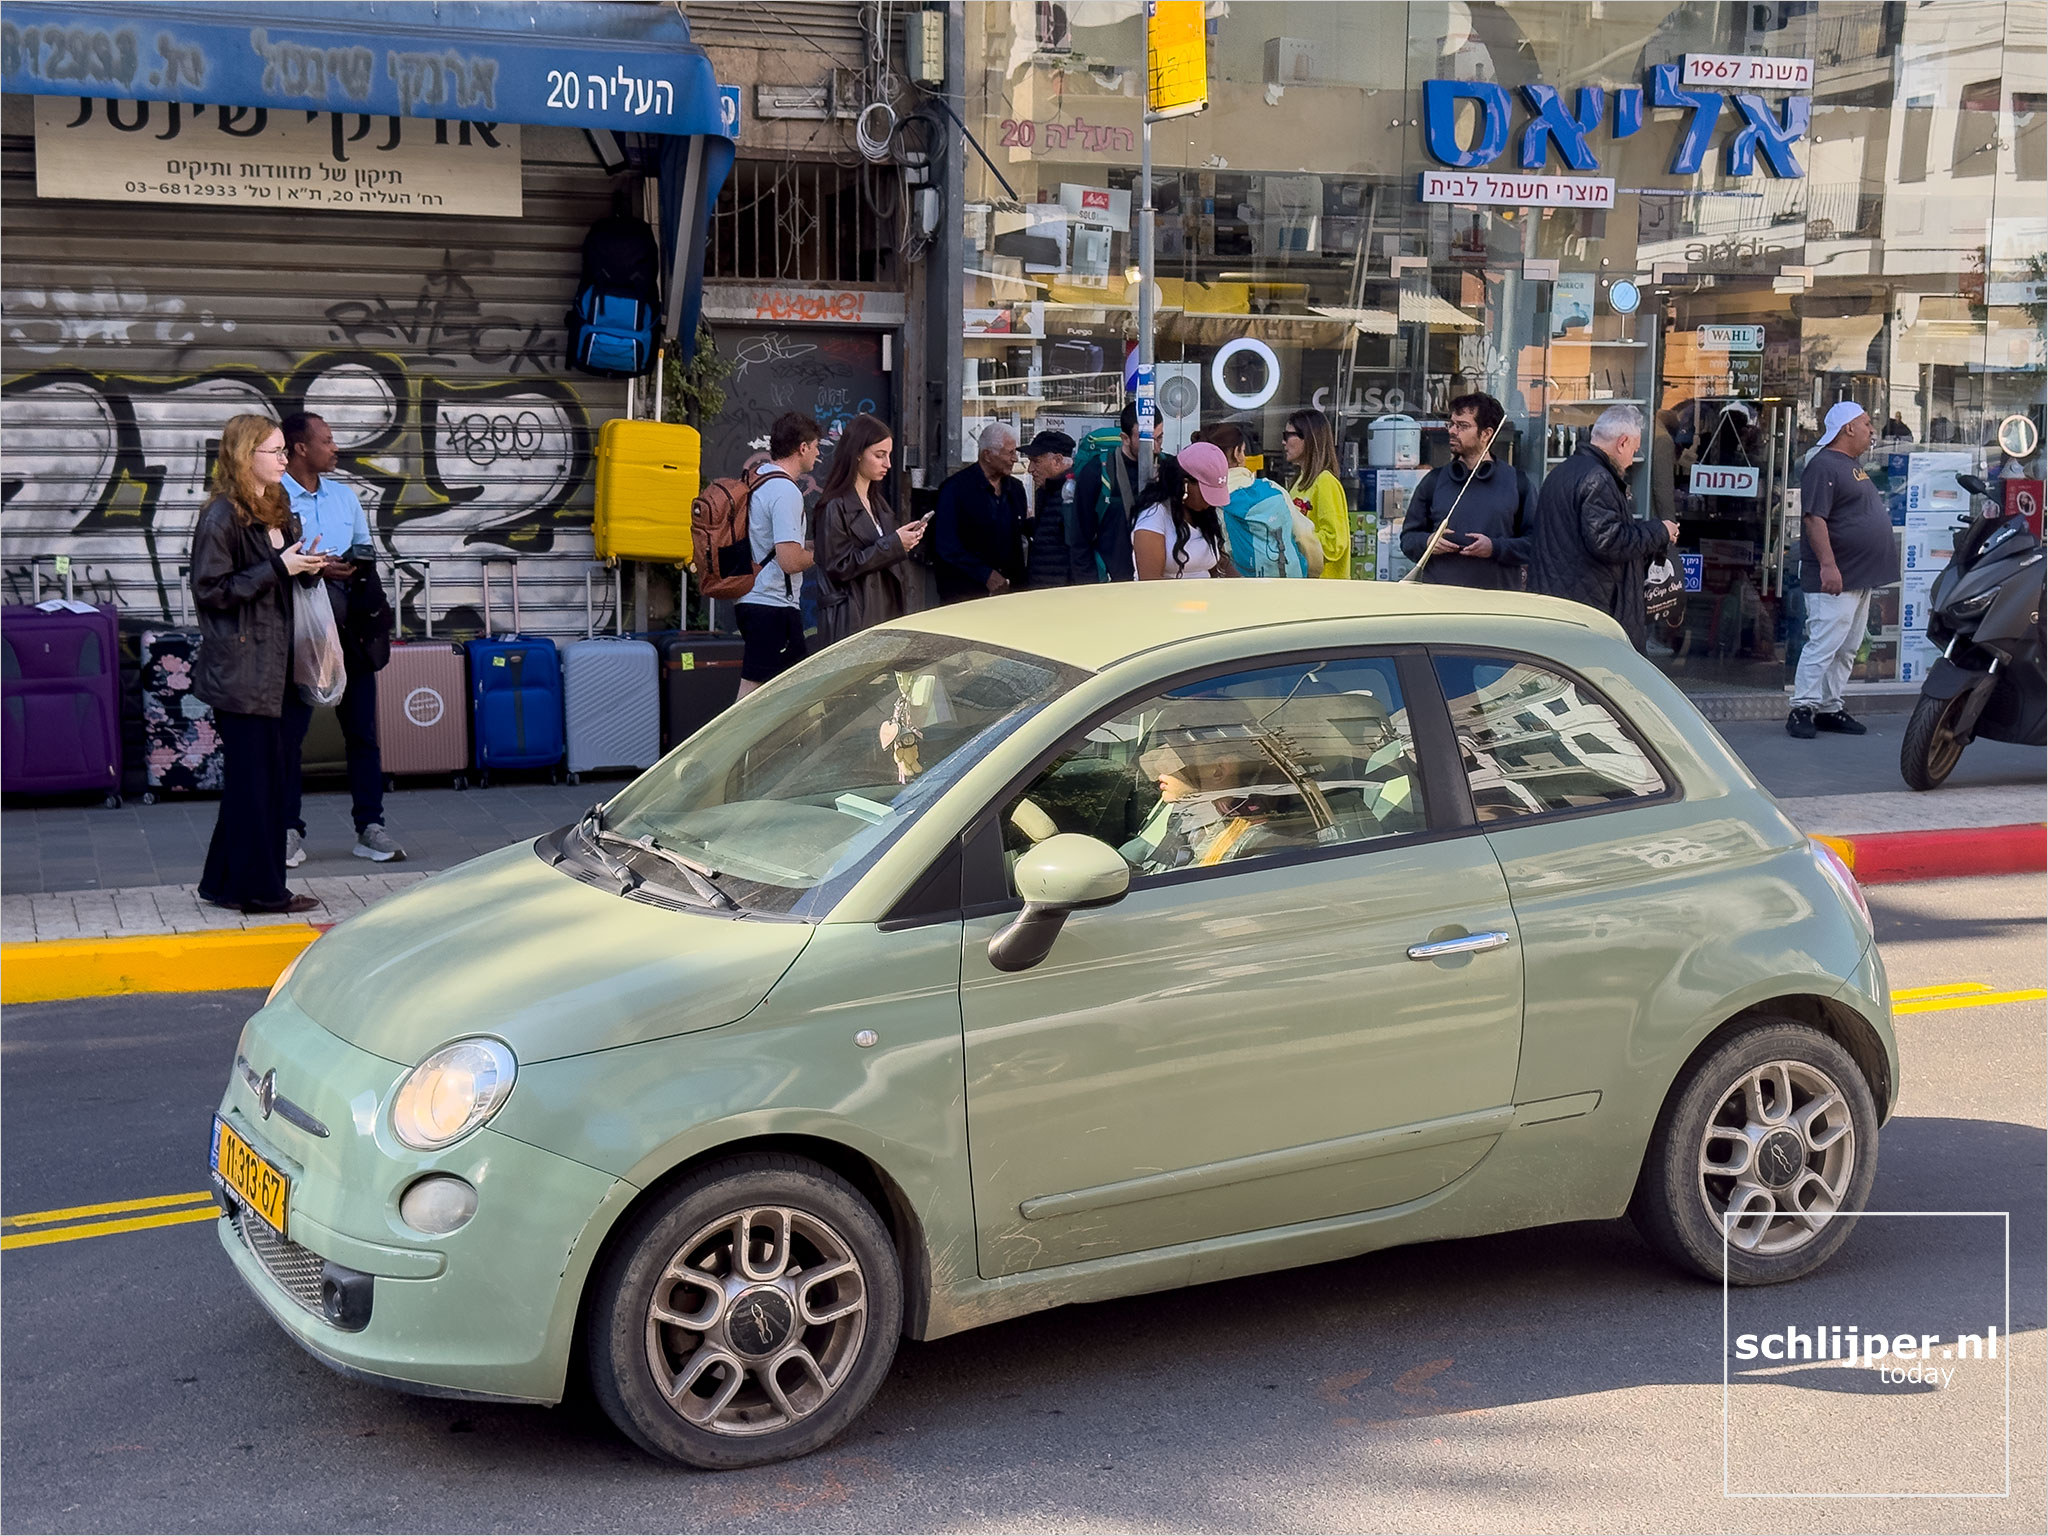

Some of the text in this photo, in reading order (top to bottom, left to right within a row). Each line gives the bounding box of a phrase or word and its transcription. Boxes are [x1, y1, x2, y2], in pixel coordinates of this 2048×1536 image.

[1690, 60, 1808, 82] משנת 1967
[547, 65, 674, 116] העליה 20
[1423, 64, 1811, 179] אליאס
[1000, 117, 1134, 152] העליה 20
[167, 159, 403, 189] תיקון של מזוודות ותיקים
[125, 181, 238, 197] 03-6812933
[359, 190, 411, 205] העליה
[1429, 176, 1609, 202] מוצרי חשמל לבית
[1712, 330, 1750, 341] WAHL
[1695, 472, 1753, 489] פתוח
[1684, 567, 1695, 575] עזר
